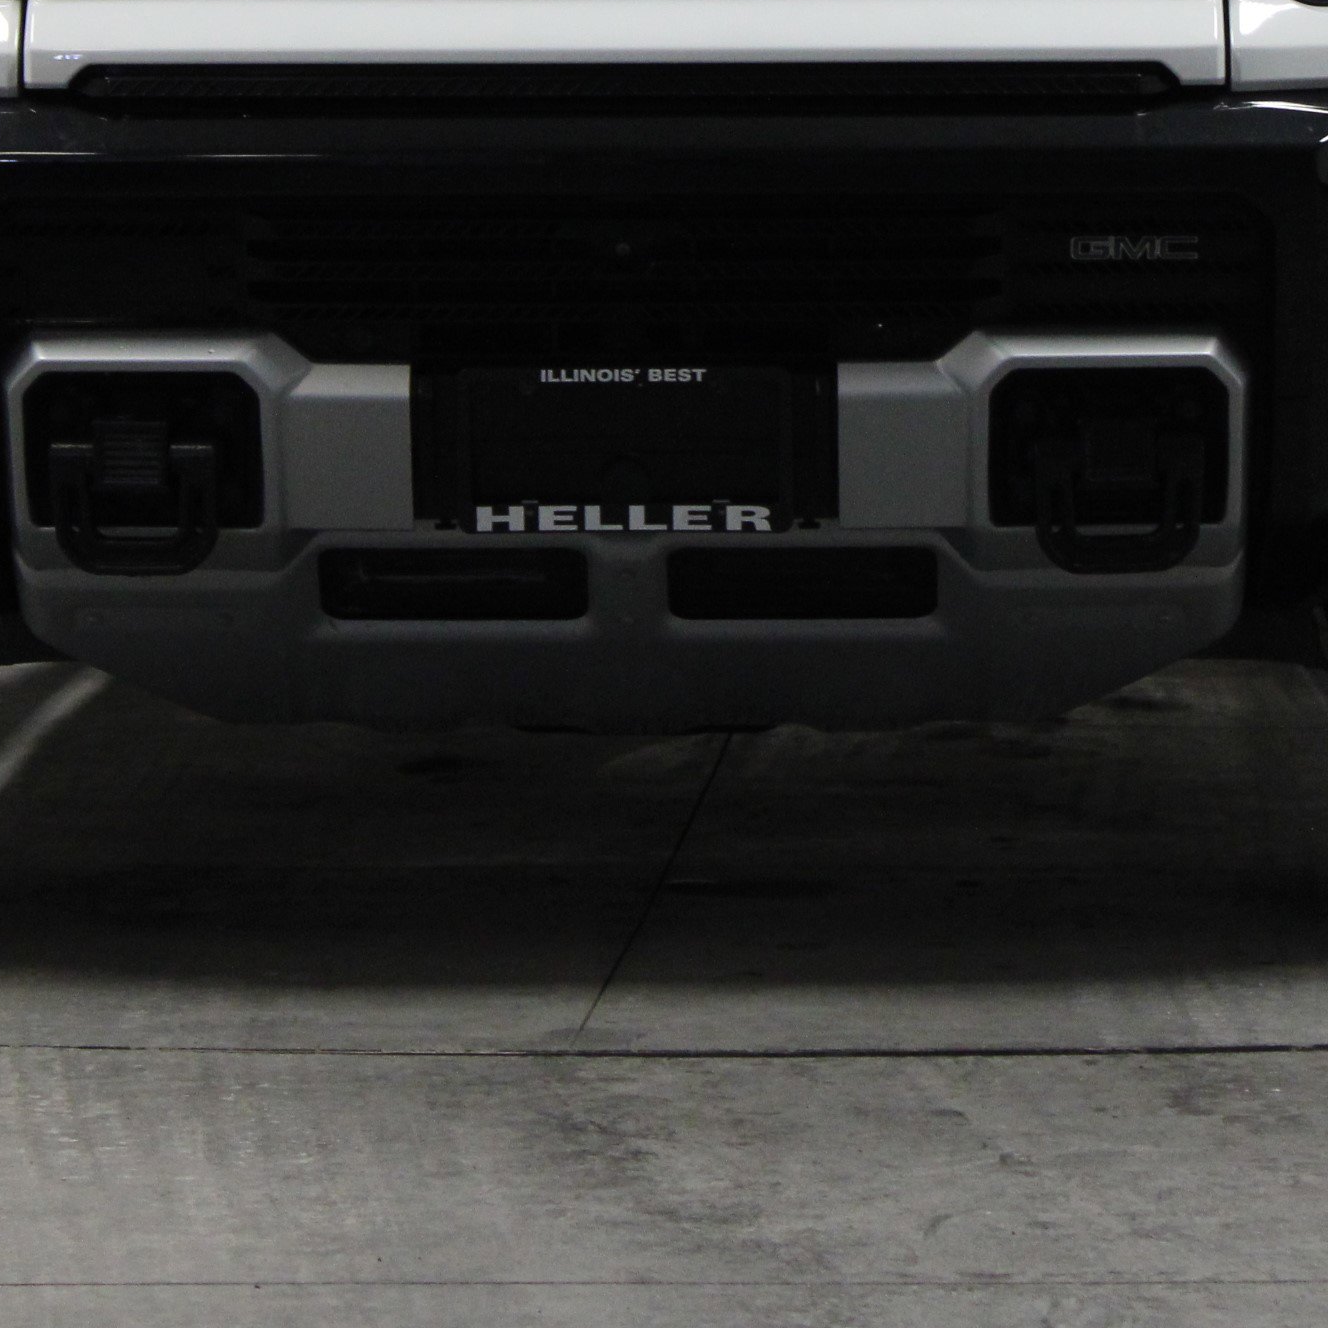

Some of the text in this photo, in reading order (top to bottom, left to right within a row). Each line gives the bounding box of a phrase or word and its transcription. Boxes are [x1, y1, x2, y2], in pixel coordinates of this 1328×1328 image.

[1069, 235, 1199, 260] GMC
[540, 368, 707, 383] ILLINOIS' BEST
[476, 504, 772, 532] HELLER
